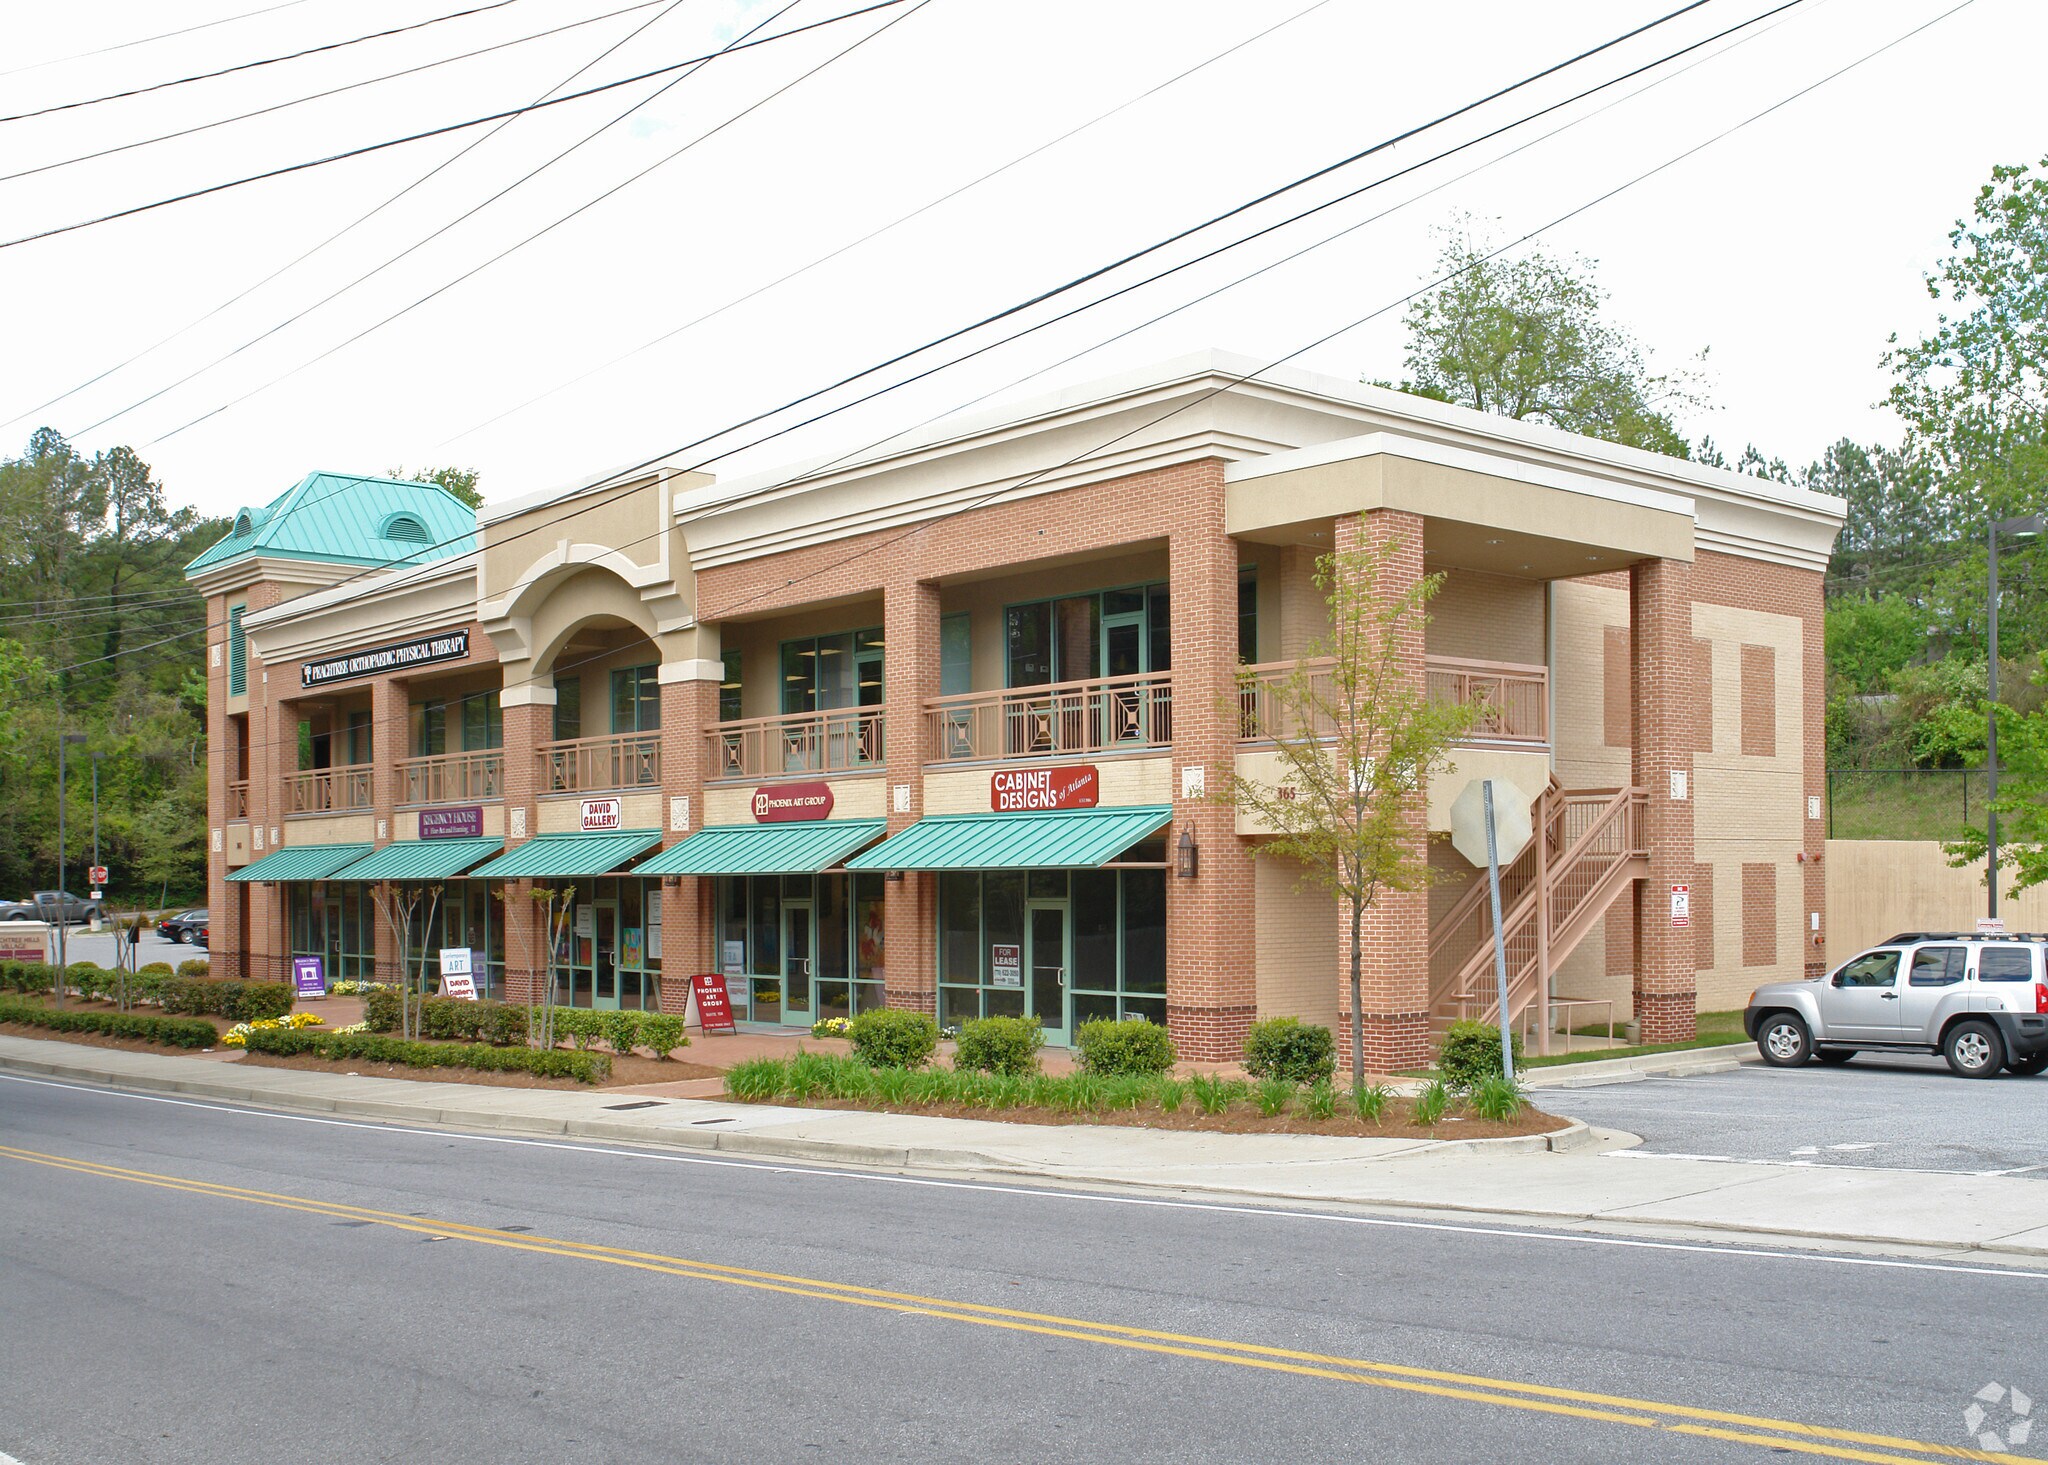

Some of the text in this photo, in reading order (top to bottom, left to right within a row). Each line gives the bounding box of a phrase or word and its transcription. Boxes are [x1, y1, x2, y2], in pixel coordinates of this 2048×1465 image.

[312, 635, 466, 681] PEACHTREE ORTHOPAEDIC PHYSICAL THERAPY
[994, 771, 1052, 791] CABINET
[1058, 773, 1092, 802] of Atlanta
[768, 796, 826, 808] PHOENIX ART GROUP
[1000, 789, 1057, 809] DESIGNS
[588, 802, 611, 815] DAVID
[453, 810, 477, 824] HOUSE
[583, 814, 617, 827] GALLERY
[91, 871, 107, 879] SOP
[999, 948, 1011, 956] FOR
[448, 960, 464, 971] ART
[994, 956, 1018, 966] LEASE
[449, 979, 470, 987] DAVID
